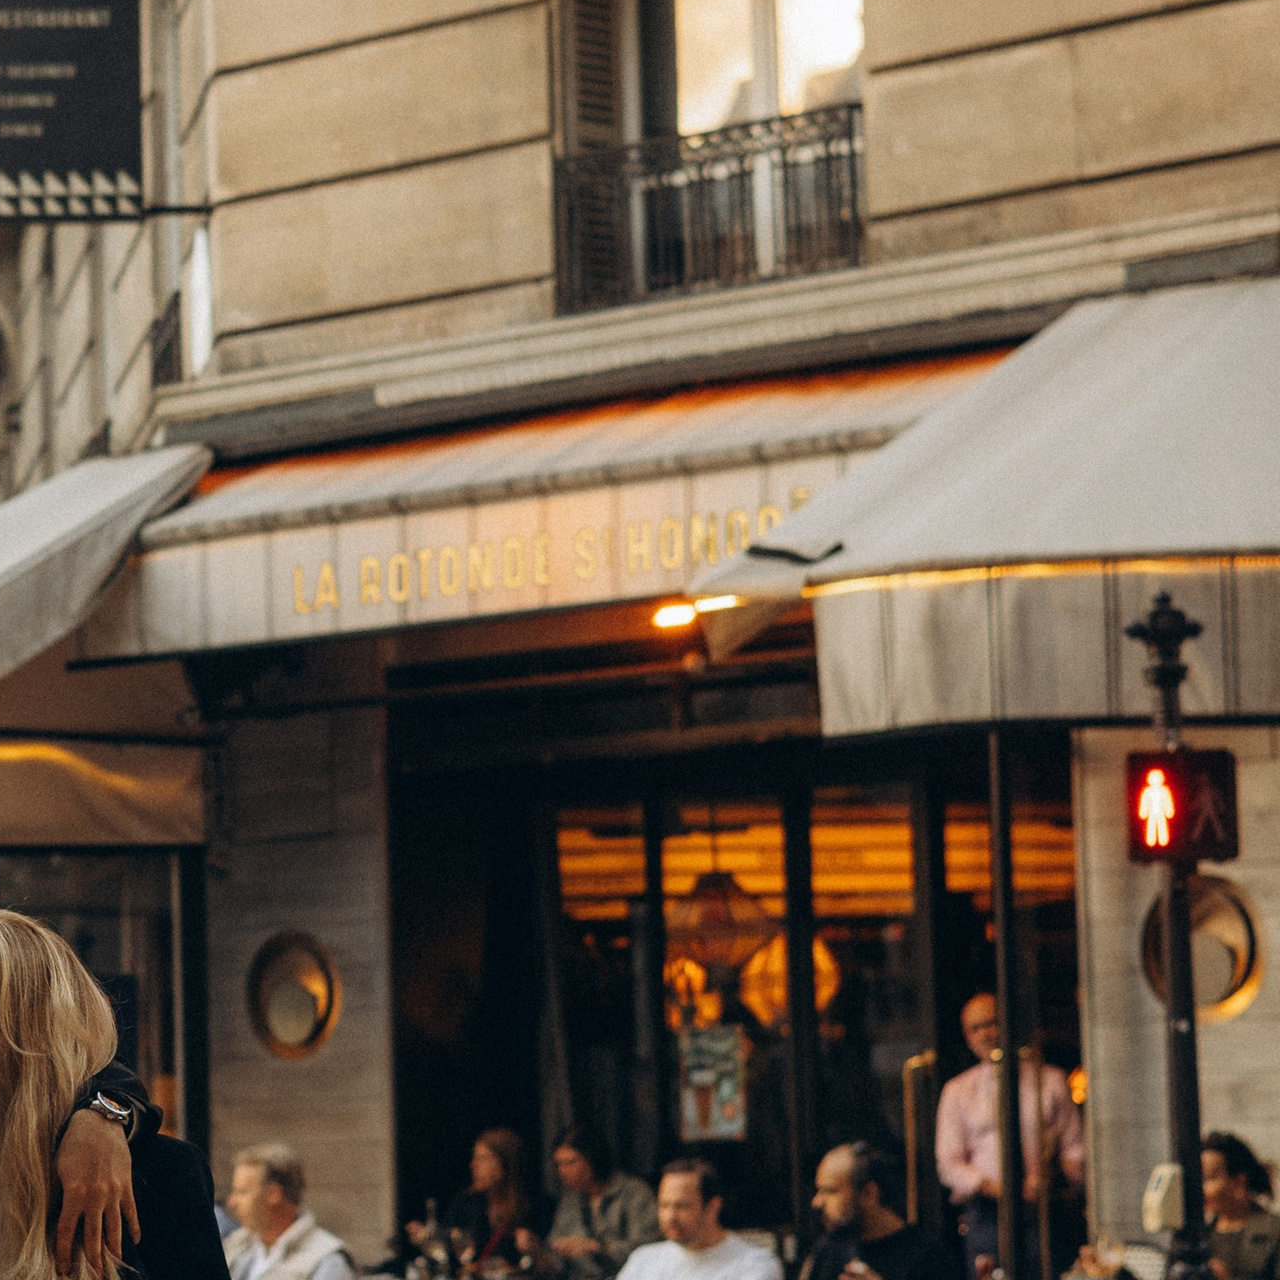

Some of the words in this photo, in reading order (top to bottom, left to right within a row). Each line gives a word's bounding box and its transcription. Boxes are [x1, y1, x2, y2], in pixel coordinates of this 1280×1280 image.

[627, 489, 812, 573] HONO
[294, 559, 340, 613] LA
[359, 532, 553, 605] ROTONDE
